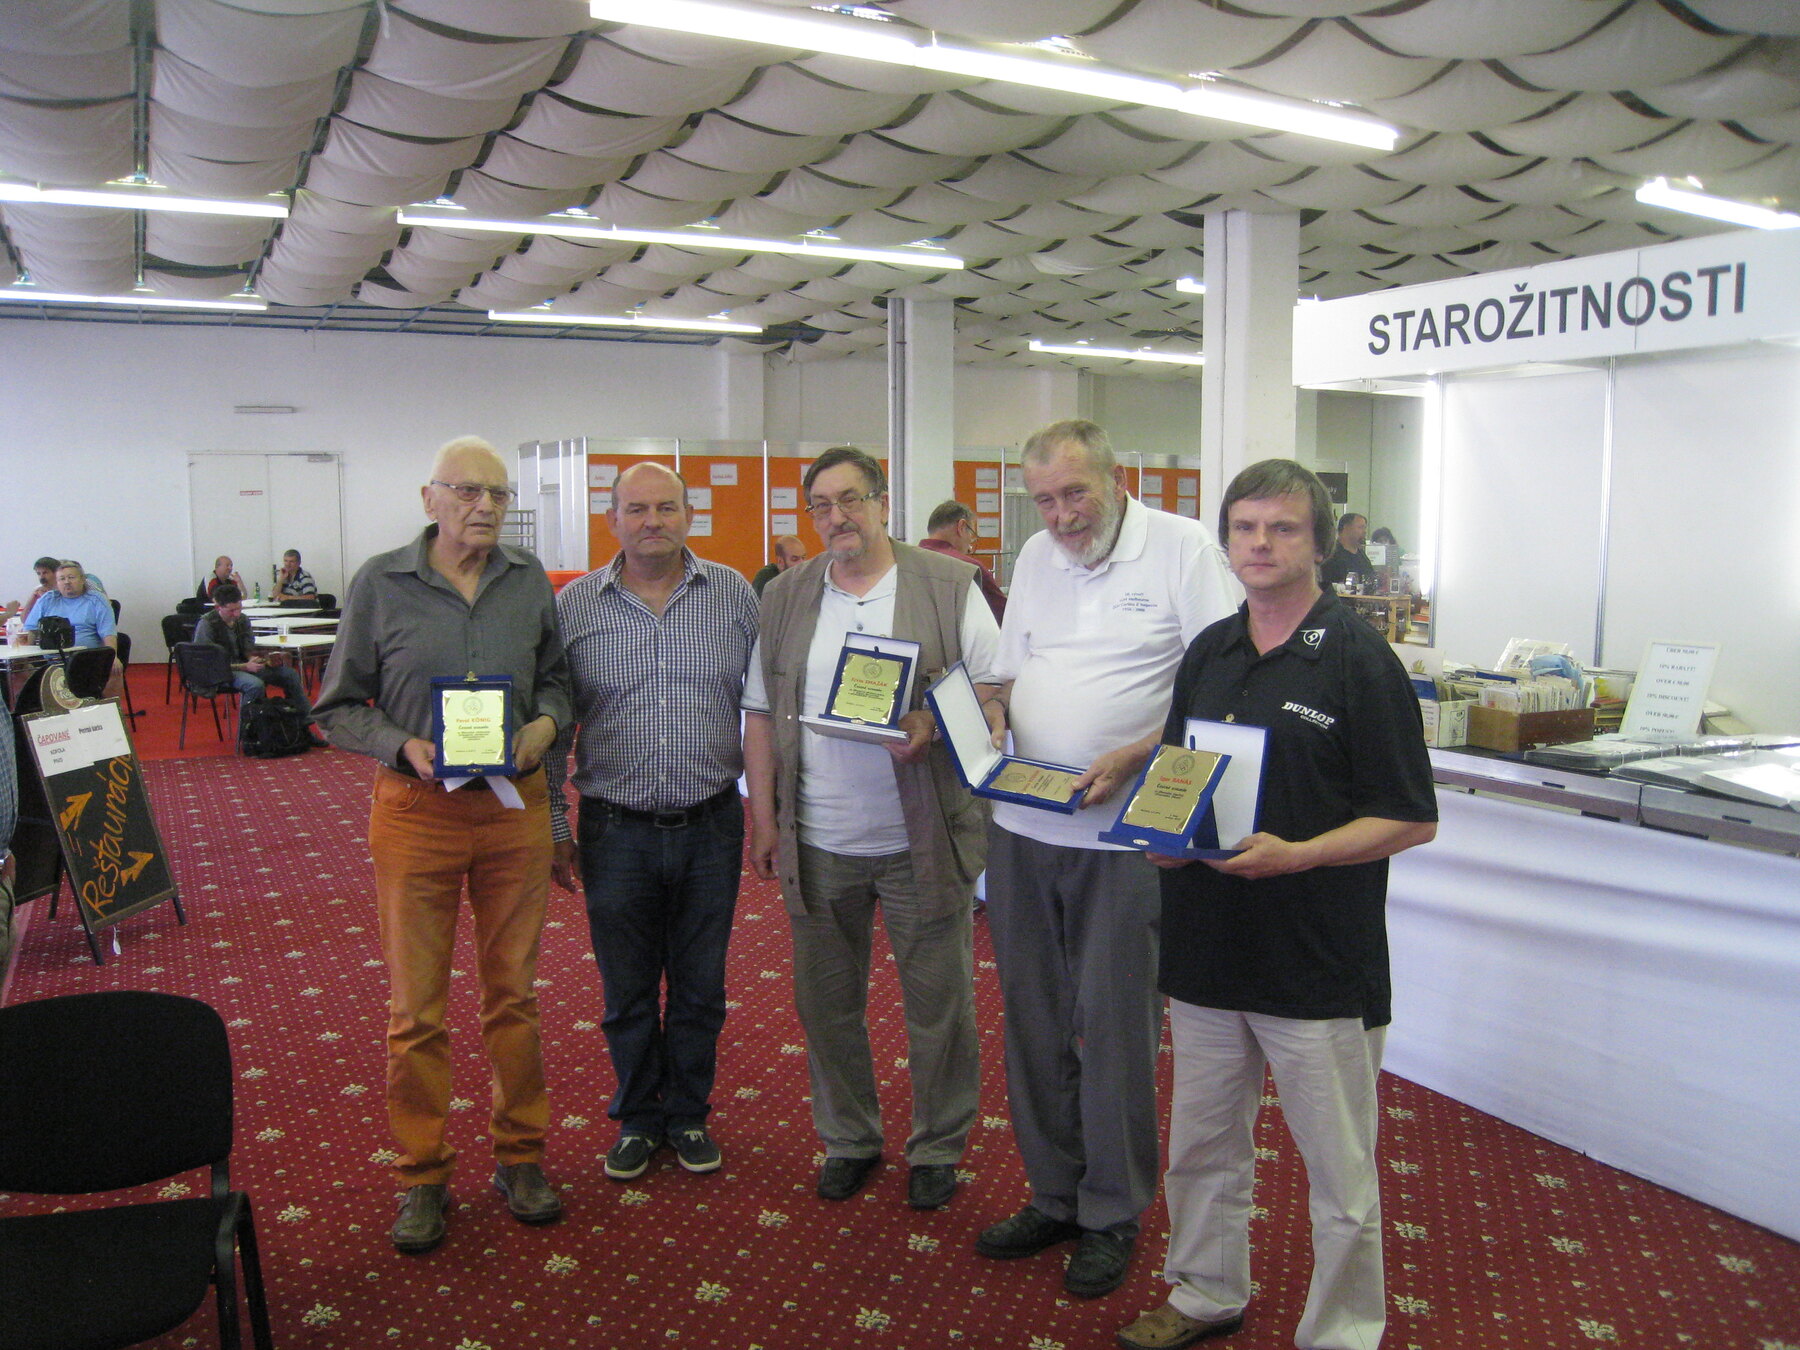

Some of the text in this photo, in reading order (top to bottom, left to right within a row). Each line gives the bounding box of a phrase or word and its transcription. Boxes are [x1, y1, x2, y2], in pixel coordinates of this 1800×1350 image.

[1367, 262, 1746, 356] STAROŽITNOSTI
[1281, 701, 1335, 726] DUNLOP
[82, 756, 133, 918] Reštauráci
